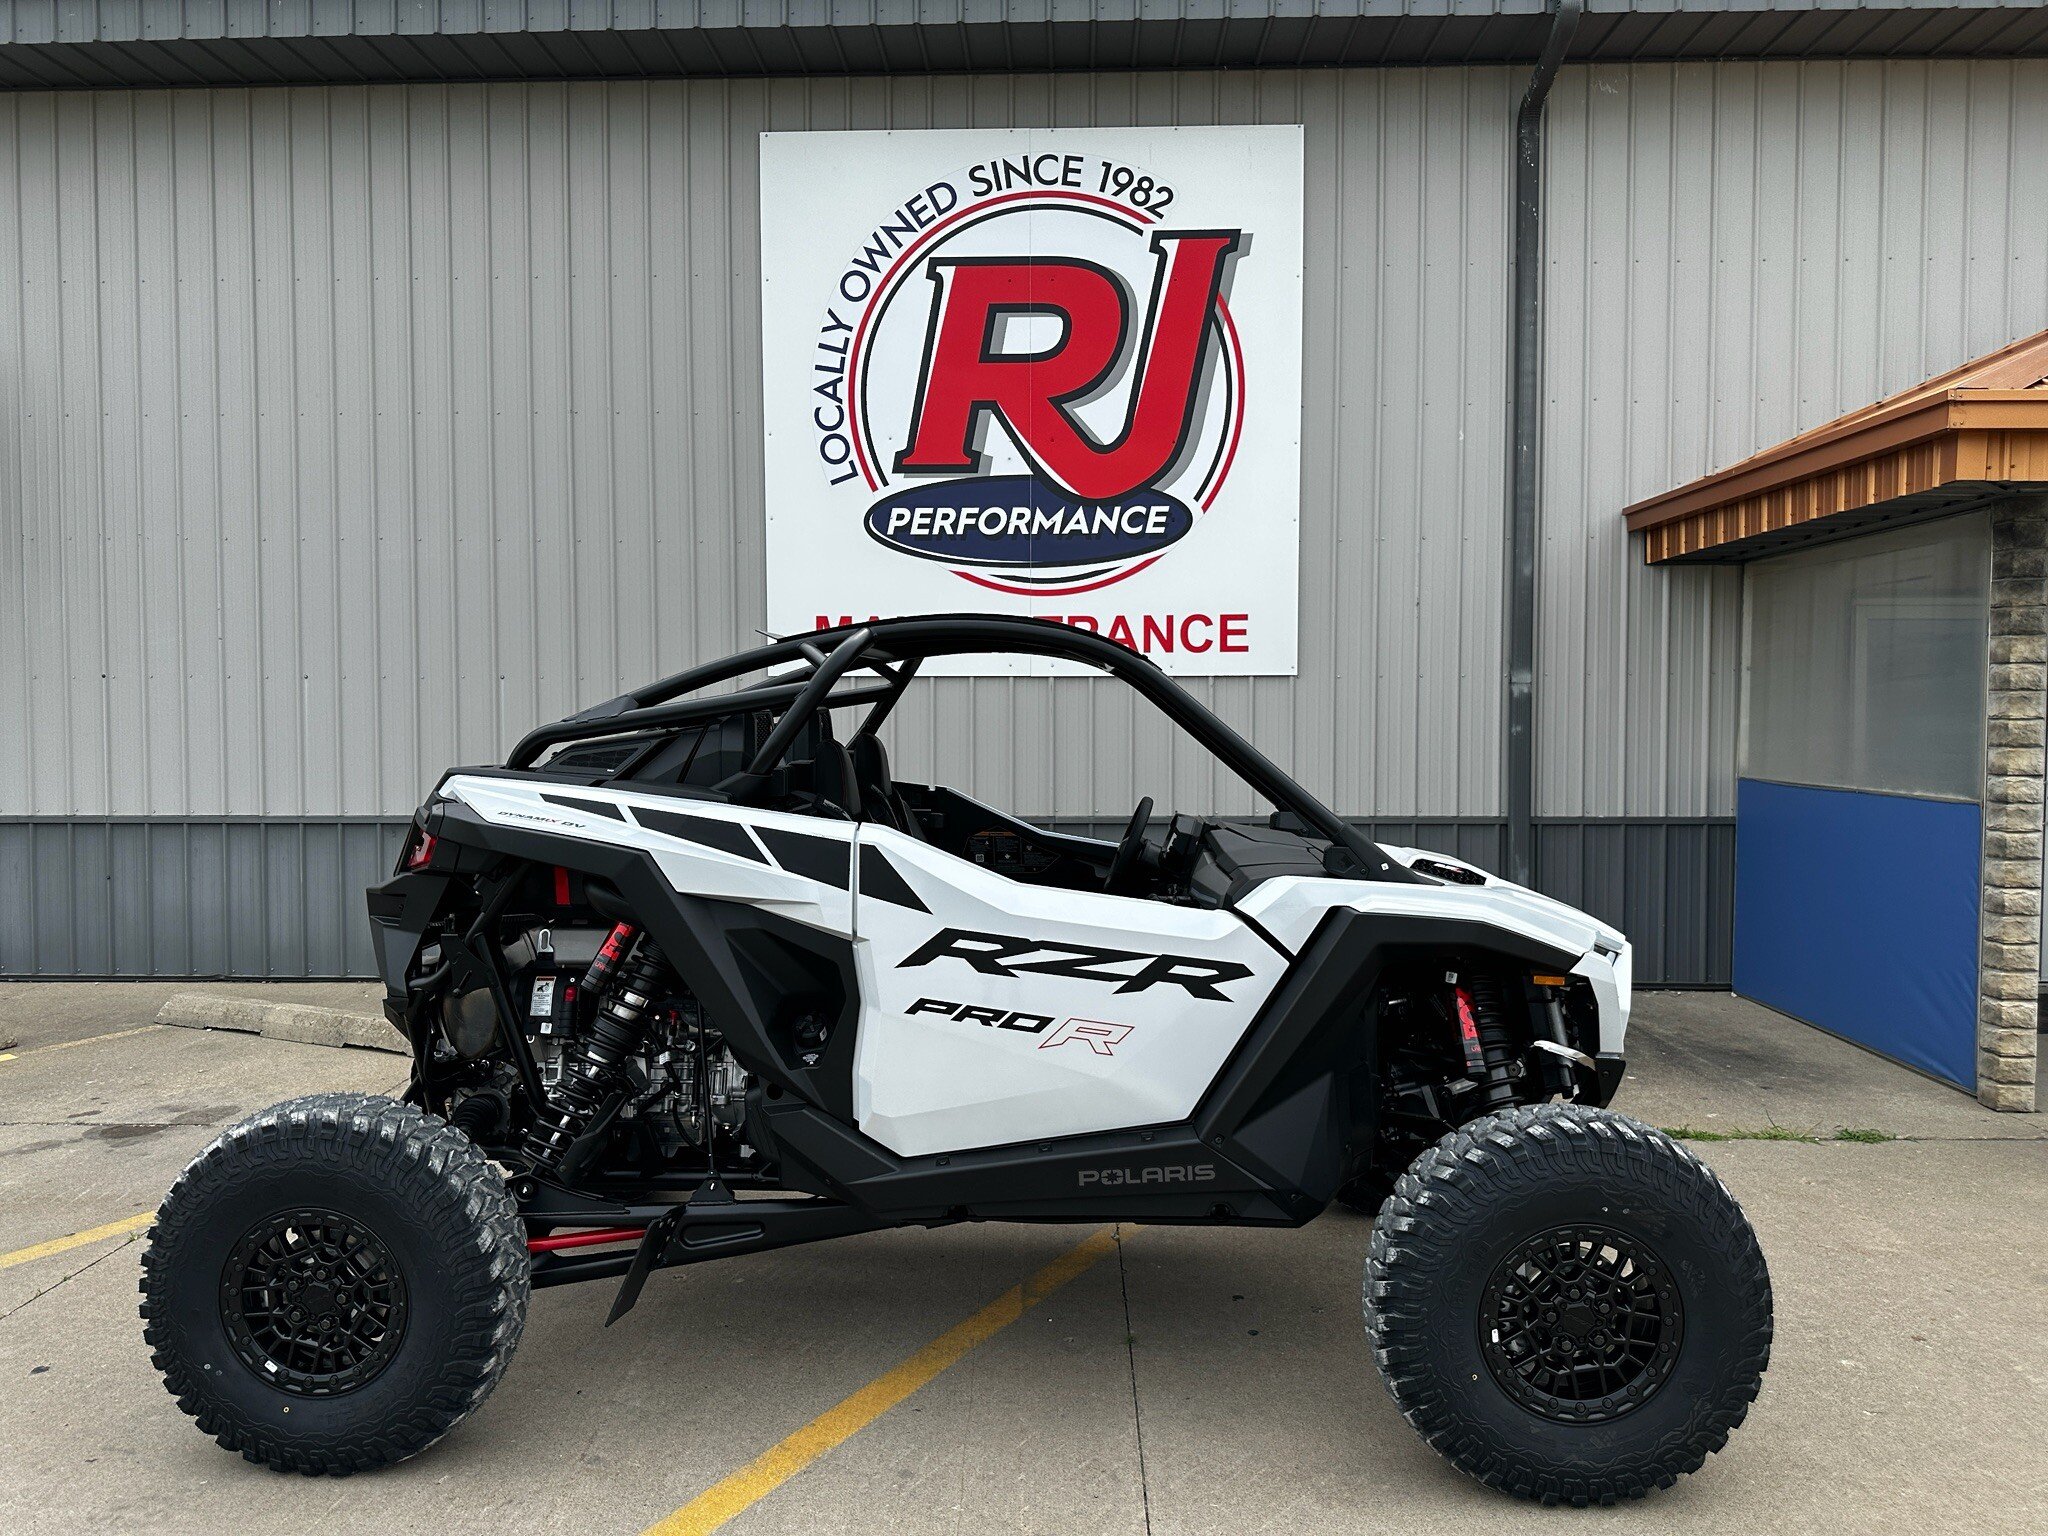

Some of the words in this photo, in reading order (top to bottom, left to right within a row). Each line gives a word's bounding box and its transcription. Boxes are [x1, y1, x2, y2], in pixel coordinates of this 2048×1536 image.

[814, 307, 859, 486] LOCALLY
[839, 181, 958, 302] OWNED
[968, 153, 1084, 197] SINCE
[1098, 160, 1175, 220] 1982
[892, 229, 1242, 500] RJ
[886, 504, 1170, 536] PERFORMANCE
[894, 927, 1256, 1003] RZR
[904, 997, 1055, 1034] PRO
[1038, 1017, 1135, 1056] R
[1078, 1164, 1216, 1187] POLARIS
